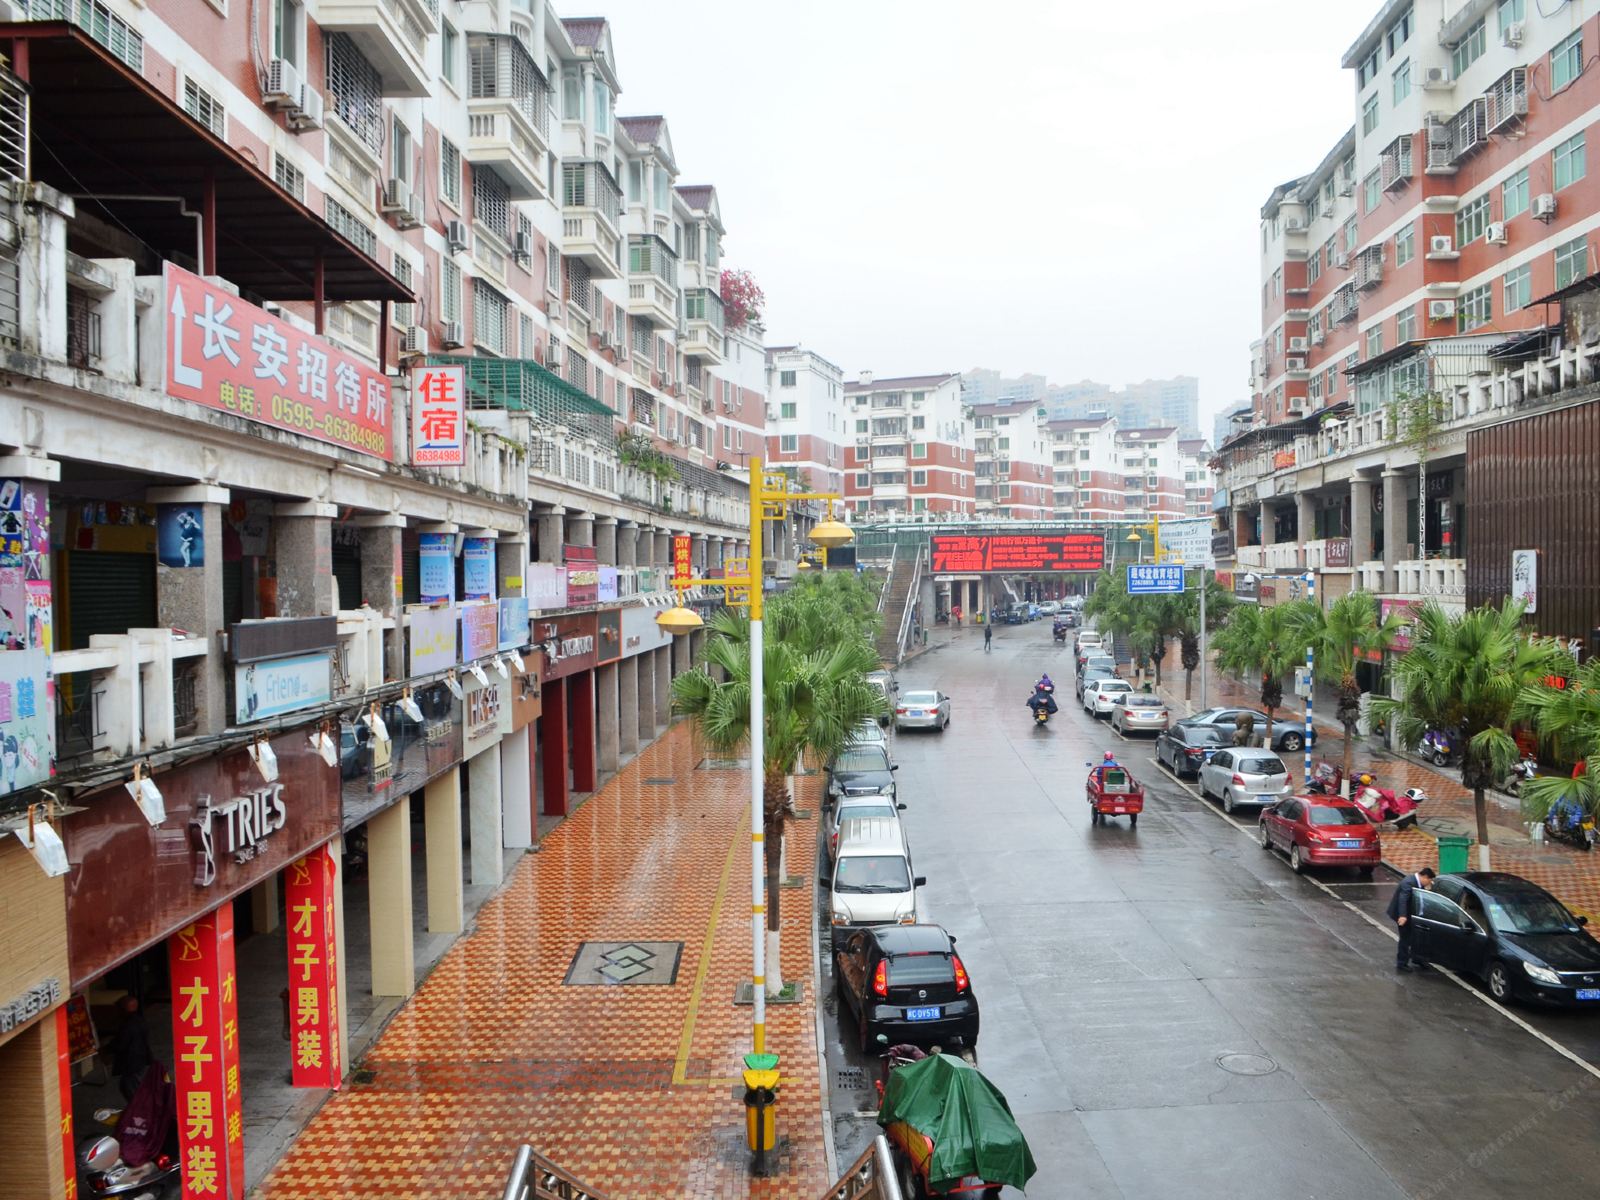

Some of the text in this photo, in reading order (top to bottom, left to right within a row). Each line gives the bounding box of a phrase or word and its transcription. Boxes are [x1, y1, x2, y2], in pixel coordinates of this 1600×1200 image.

[193, 293, 387, 426] 长安招待所
[418, 372, 458, 440] 住宿
[416, 450, 461, 462] 86384988
[675, 538, 689, 548] DIY
[222, 783, 286, 853] TRIES
[292, 897, 323, 1069] 才子男装
[179, 976, 219, 1195] 才子男装
[222, 971, 241, 1144] 才子男装
